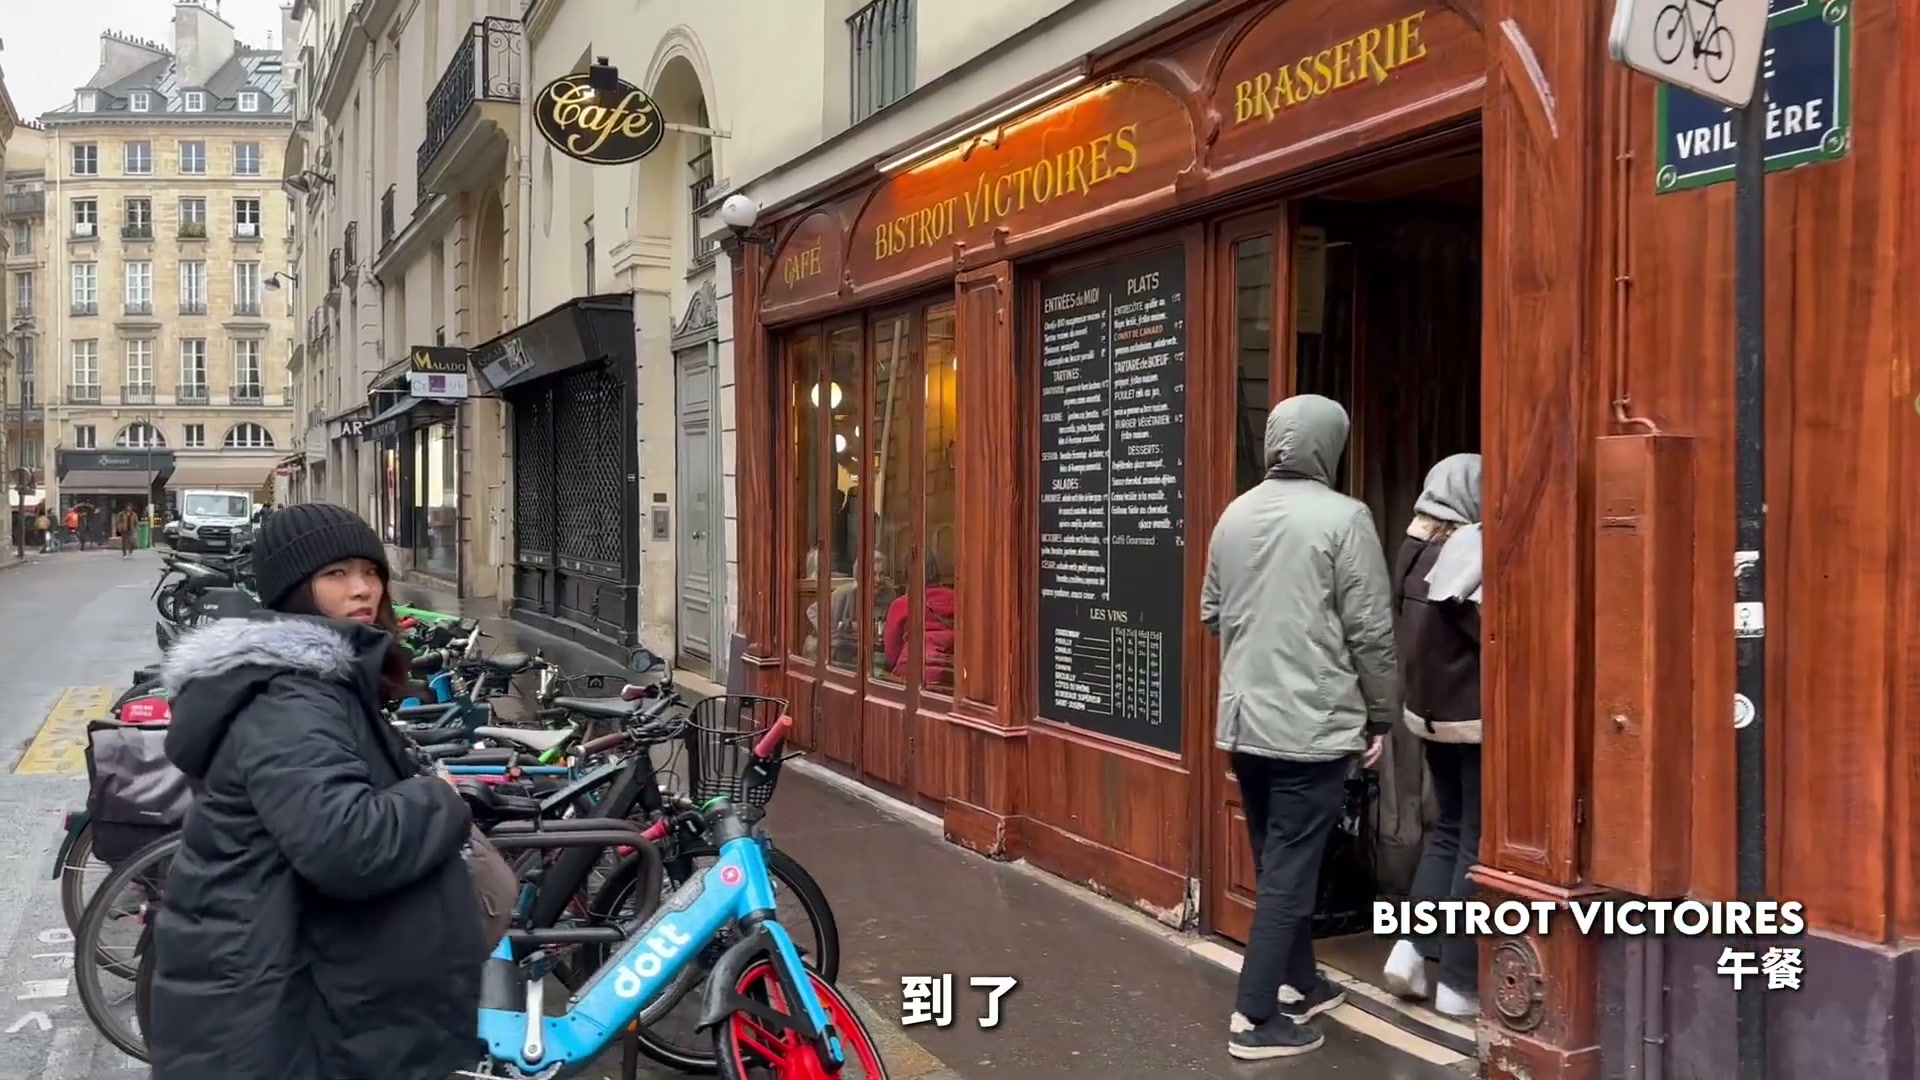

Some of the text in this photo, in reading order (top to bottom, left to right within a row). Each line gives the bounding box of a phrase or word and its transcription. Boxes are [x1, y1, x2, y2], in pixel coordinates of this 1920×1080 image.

[1234, 10, 1427, 124] BRASSERIE
[550, 81, 653, 155] Café
[1676, 98, 1823, 159] VRILÈRE
[875, 122, 1138, 261] BISTROT VICTOIRES
[784, 235, 821, 290] CAFÉ
[1127, 271, 1159, 296] PLATS
[1044, 293, 1075, 314] ENTRÉES
[1083, 287, 1099, 305] MIDI
[413, 350, 466, 371] MALADO
[1089, 607, 1128, 623] LES VINS
[614, 924, 690, 998] dott
